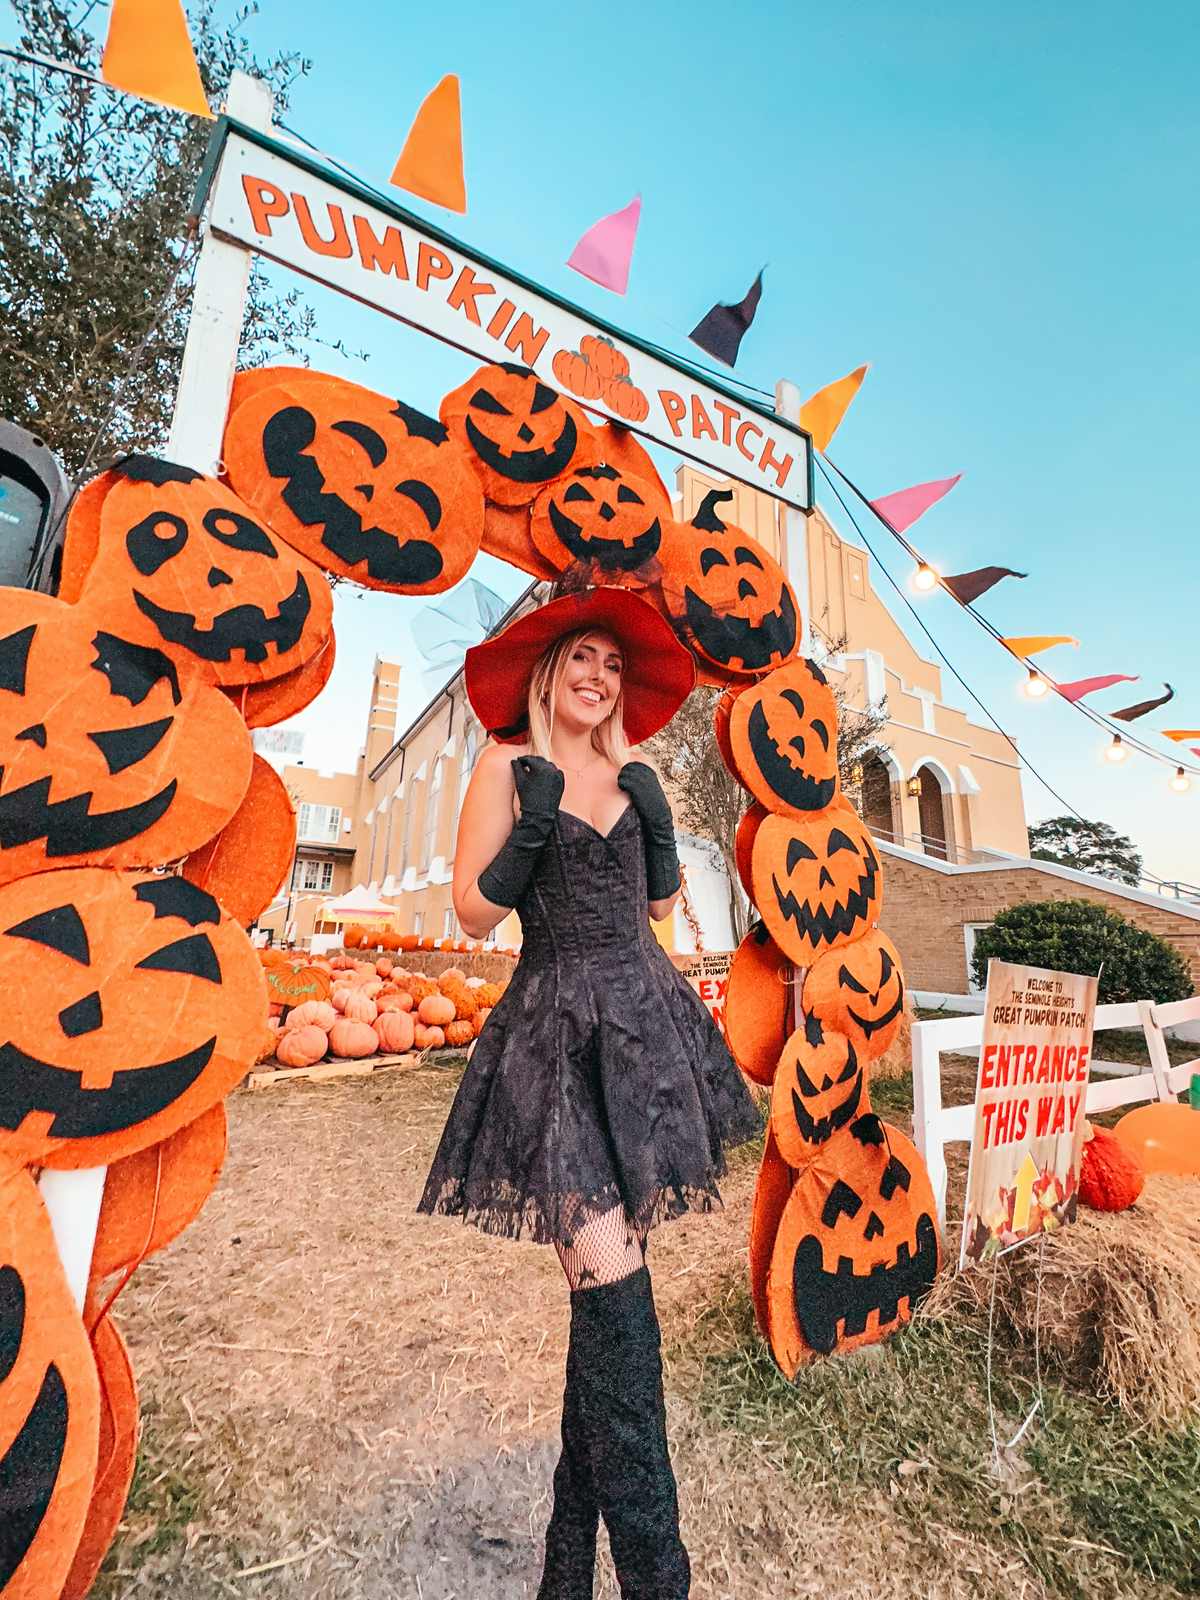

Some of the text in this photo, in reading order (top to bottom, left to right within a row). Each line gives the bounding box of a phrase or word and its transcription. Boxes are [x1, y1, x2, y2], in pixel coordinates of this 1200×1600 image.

[241, 174, 794, 489] PUMPKIN PATCH
[1011, 991, 1075, 1009] THE SEMINOLE HEIGHTS
[1027, 978, 1063, 994] WELCOME TO
[993, 1006, 1087, 1028] GREAT PUMPKIN PATCH
[980, 1045, 1089, 1089] ENTRANCE
[982, 1094, 1081, 1150] THIS WAY
